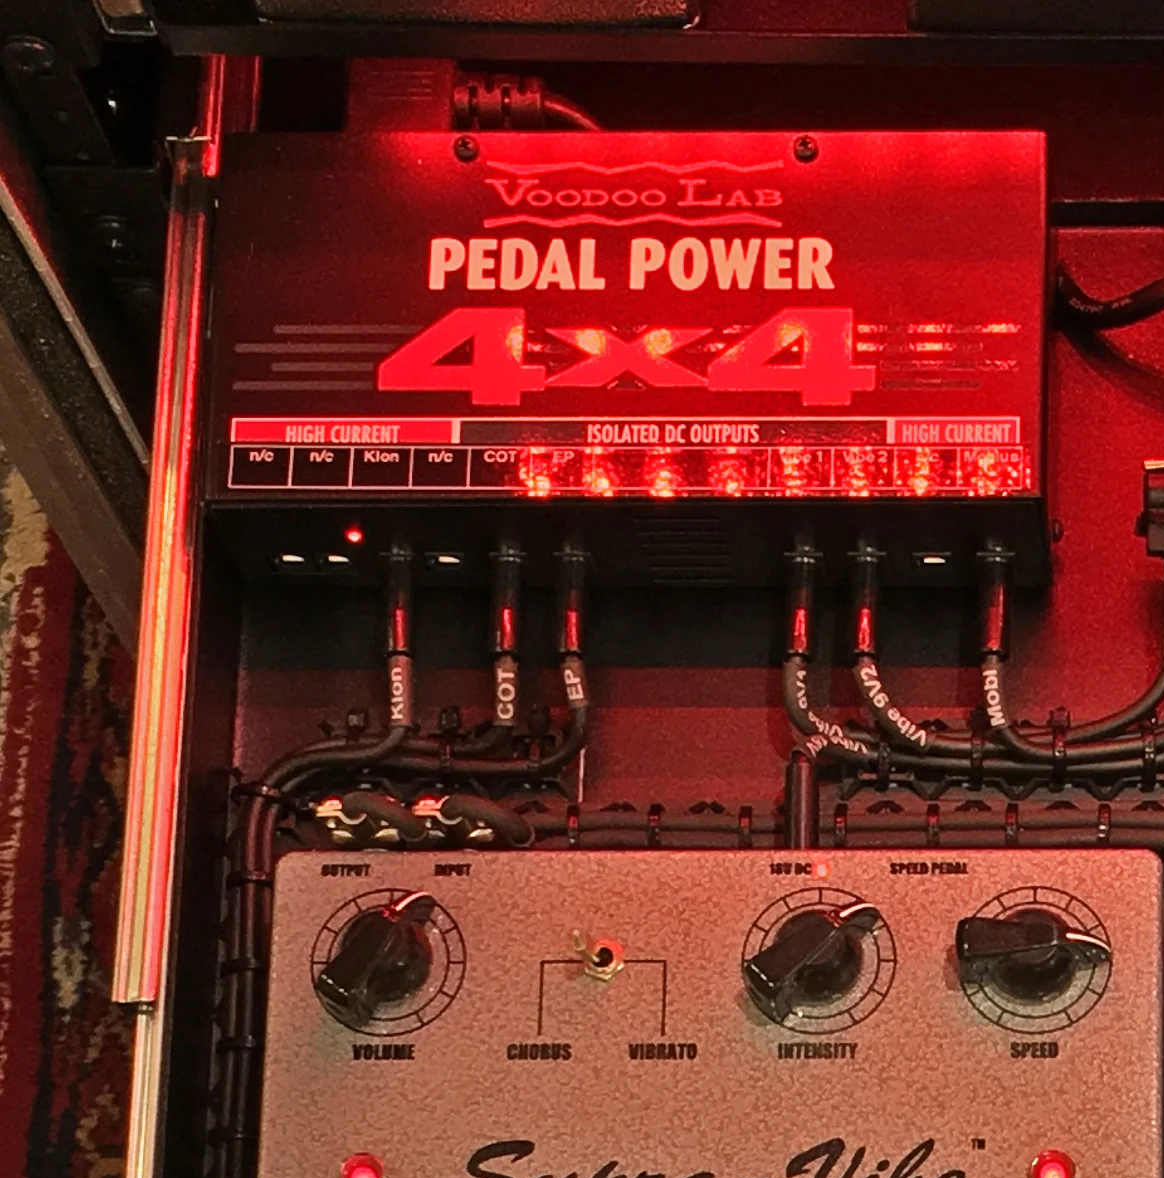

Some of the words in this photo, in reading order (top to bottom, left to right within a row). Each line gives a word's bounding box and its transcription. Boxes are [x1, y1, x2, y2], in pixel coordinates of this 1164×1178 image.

[429, 236, 605, 292] PEDAL
[629, 236, 836, 291] POWER
[285, 425, 325, 443] HIGH
[329, 425, 401, 444] CURRENT
[587, 424, 660, 445] ISOLATED
[665, 424, 686, 445] DC
[690, 424, 760, 445] OUTPUTS
[901, 424, 942, 443] HIGH
[944, 424, 1012, 443] CURRENT
[249, 450, 275, 462] n/c
[309, 450, 335, 463] n/c
[363, 450, 399, 463] Klon
[428, 450, 453, 463] n/c
[482, 451, 518, 463] COT
[390, 666, 404, 720] Klon
[564, 668, 585, 701] EP
[860, 664, 889, 708] 9V2
[496, 668, 516, 720] COT
[887, 706, 927, 747] Vibe
[321, 863, 372, 877] OUTPUT
[433, 863, 473, 877] INPUT
[889, 862, 929, 876] SPEED
[931, 862, 969, 876] PEDAL
[351, 1043, 416, 1061] VOLUME
[506, 1042, 572, 1061] CHORUS
[628, 1042, 698, 1061] VIBRATO
[777, 1042, 858, 1060] INTENSITY
[1010, 1042, 1059, 1060] SPEED
